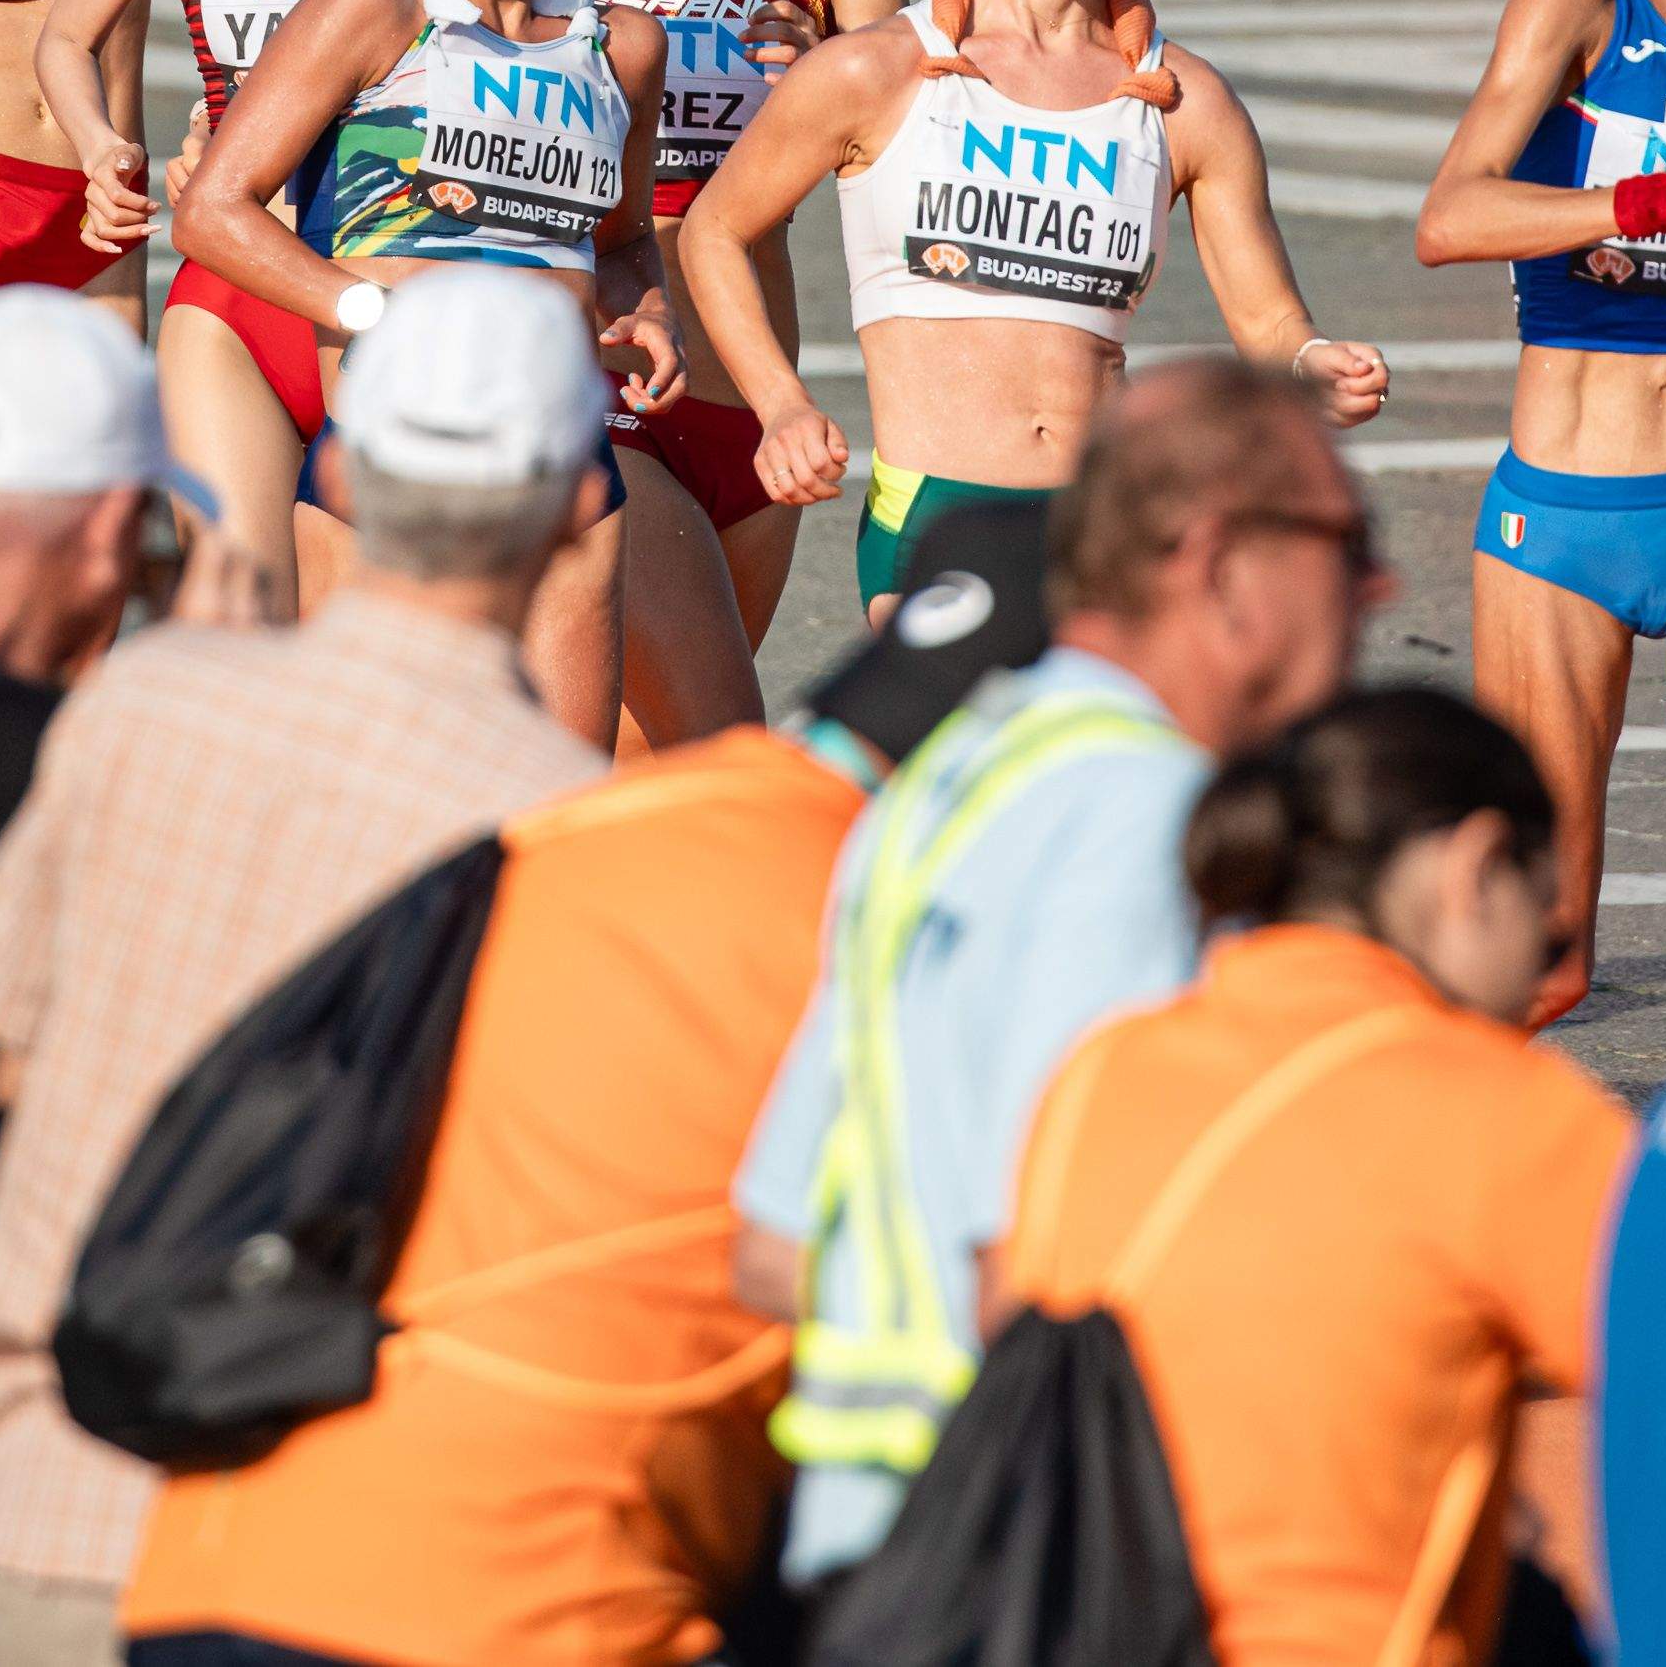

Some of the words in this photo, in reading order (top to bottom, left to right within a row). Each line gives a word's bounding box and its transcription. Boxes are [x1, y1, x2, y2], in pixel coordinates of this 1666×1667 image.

[224, 13, 283, 59] YA
[666, 20, 765, 76] TN
[474, 61, 594, 134] NTN
[661, 91, 744, 131] REZ
[431, 124, 582, 189] MOREJÓN
[590, 156, 616, 200] 121
[962, 119, 1118, 196] NTN
[483, 195, 584, 231] BUDAPEST
[917, 181, 1094, 255] MONTAG
[1107, 219, 1141, 262] 101
[977, 256, 1098, 294] BUDAPEST
